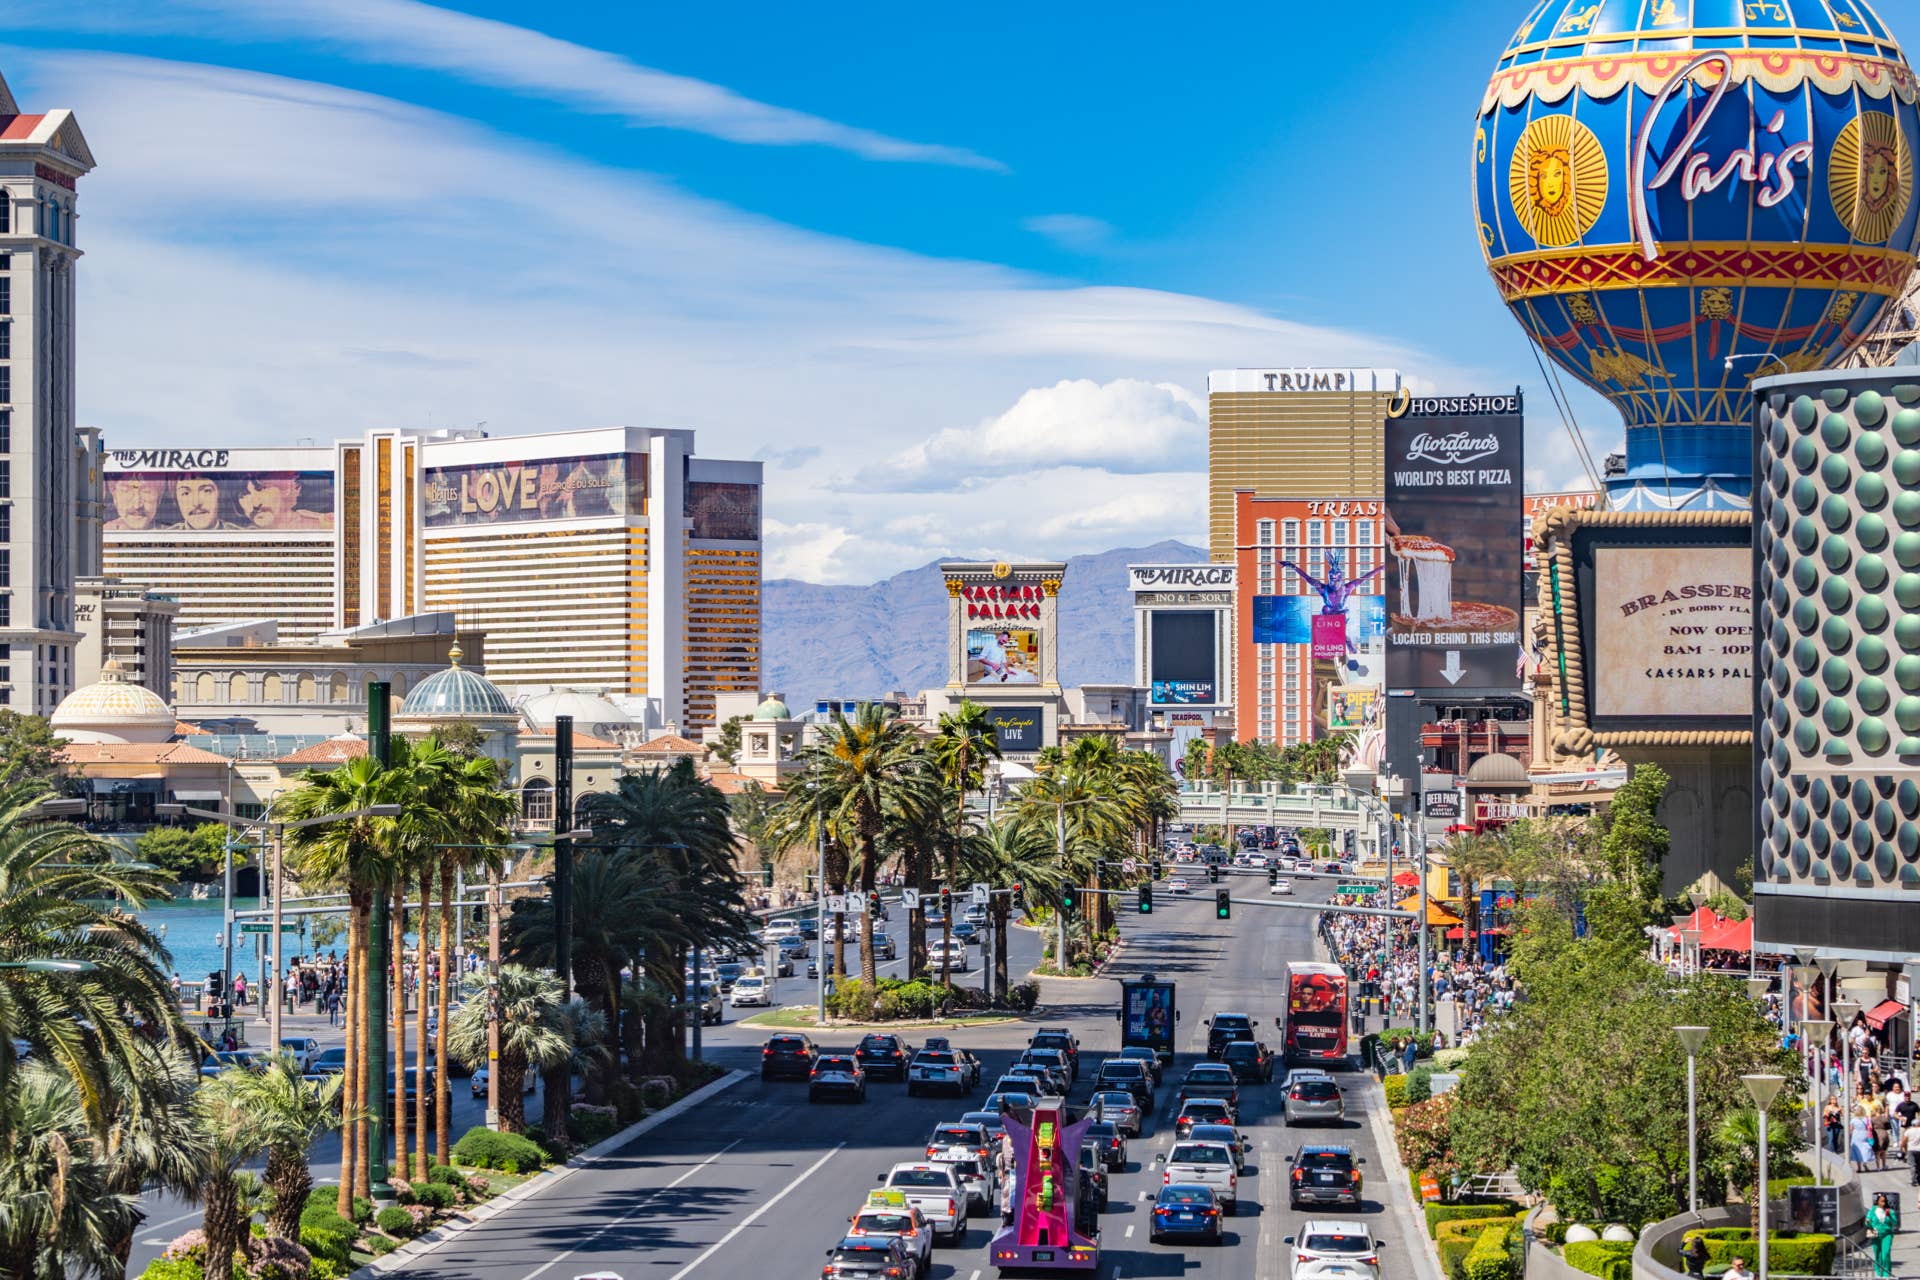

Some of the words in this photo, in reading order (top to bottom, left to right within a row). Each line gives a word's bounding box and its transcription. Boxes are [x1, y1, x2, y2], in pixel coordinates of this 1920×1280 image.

[1632, 49, 1815, 262] Paris
[1264, 373, 1346, 391] TRUMP
[1411, 397, 1518, 414] HORSESHOE
[1406, 431, 1499, 464] Giordano's
[112, 451, 137, 462] THE
[120, 450, 229, 468] MIRAGE
[1394, 470, 1443, 486] WORLD'S
[1446, 470, 1475, 485] BEST
[1478, 469, 1511, 485] PIZZA
[461, 468, 538, 513] LOVE
[577, 480, 587, 488] DU
[1307, 500, 1385, 517] TREAS
[1134, 569, 1155, 579] THE
[1142, 569, 1232, 586] MIRAGE
[961, 586, 1045, 603] CAESARS
[1155, 594, 1175, 602] INO
[1200, 594, 1229, 602] SORT
[1620, 584, 1752, 617] BRASSER
[74, 604, 96, 613] OBU
[968, 603, 1041, 620] PALACE
[1670, 608, 1684, 616] BY
[1730, 606, 1751, 614] FLA
[1669, 626, 1708, 635] NOW
[1392, 633, 1431, 645] LOCATED
[1434, 633, 1467, 644] BEHIND
[1470, 632, 1491, 644] THIS
[1493, 632, 1515, 644] SIGN
[1663, 645, 1702, 655] 8AM
[1721, 646, 1752, 655] 10P
[1645, 668, 1715, 678] CAESARS
[1722, 668, 1752, 678] PAL
[1347, 692, 1374, 706] PIFF
[1005, 729, 1022, 739] LIVE
[1426, 793, 1442, 806] BEER
[1443, 793, 1459, 806] PARK
